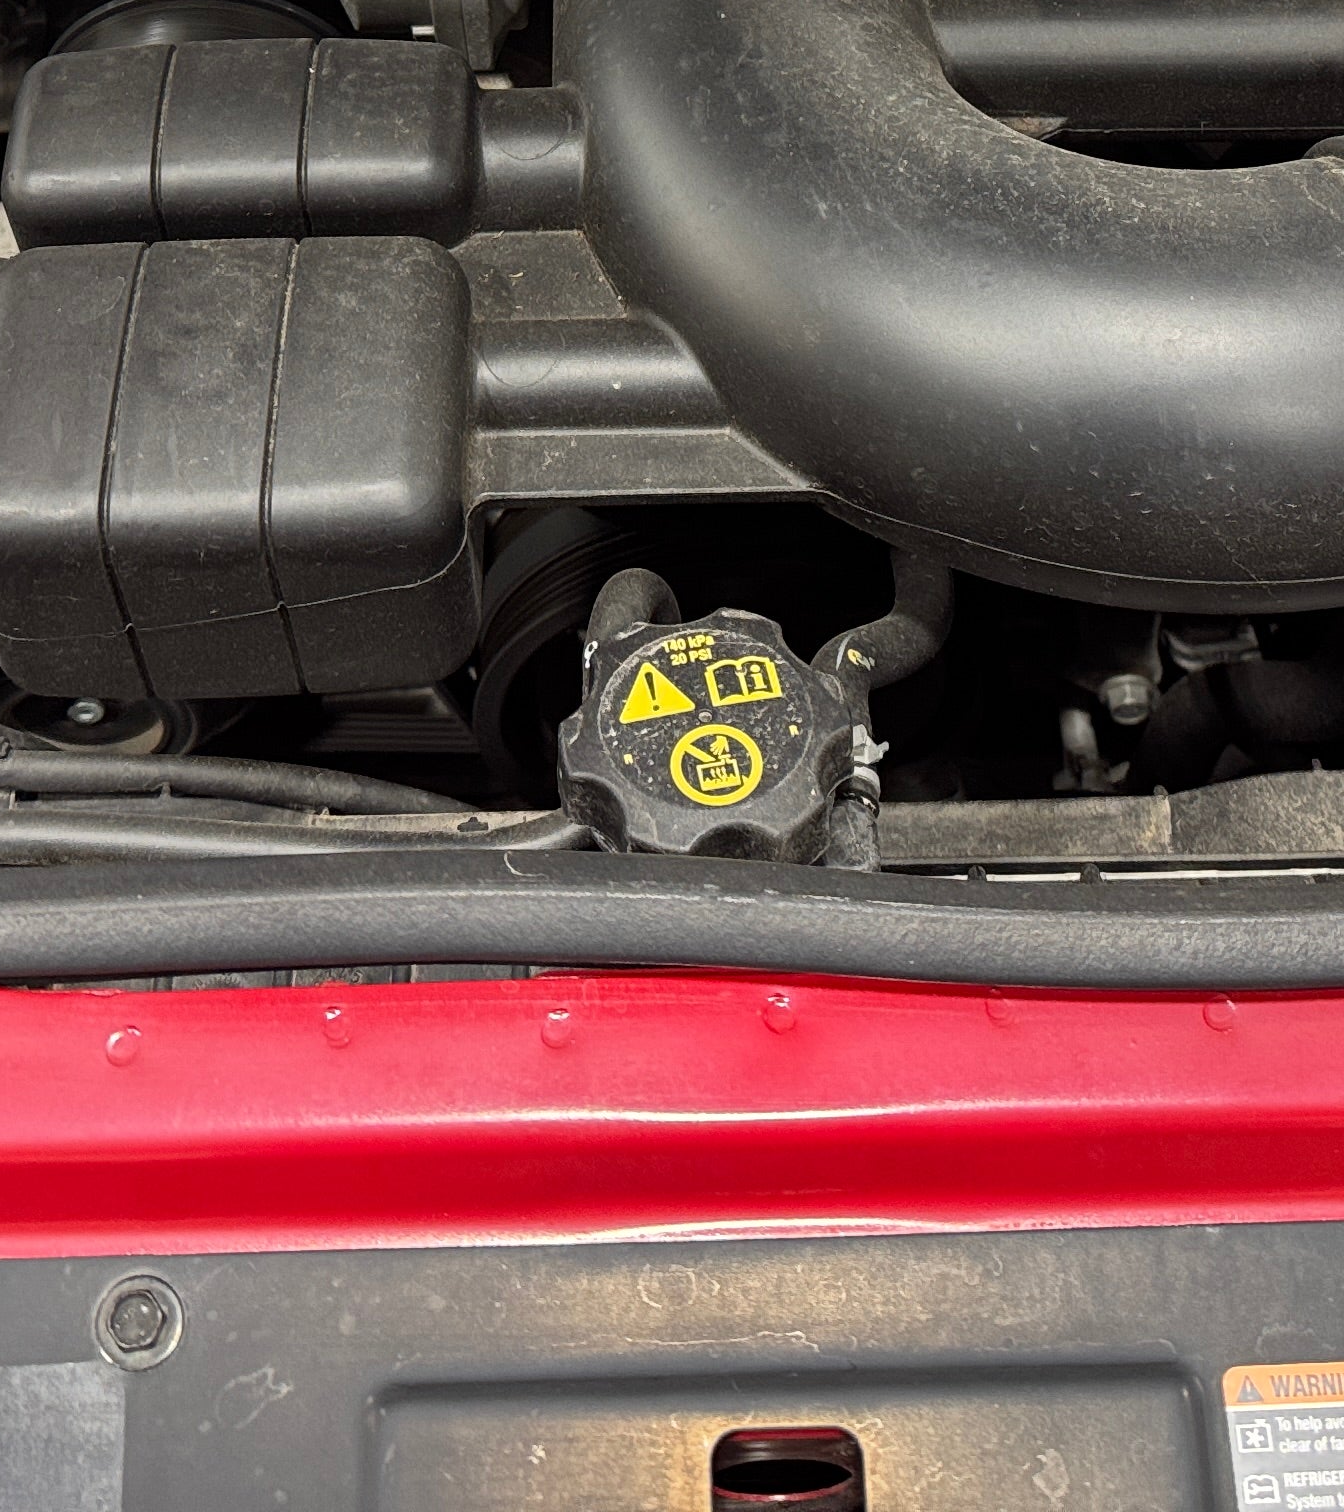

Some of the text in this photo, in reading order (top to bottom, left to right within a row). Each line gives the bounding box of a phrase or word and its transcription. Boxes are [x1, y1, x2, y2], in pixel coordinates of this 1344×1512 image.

[661, 634, 715, 654] 140 kPa
[670, 647, 713, 666] 20 PSI
[1274, 1416, 1293, 1432] To
[1293, 1415, 1324, 1433] help
[1279, 1437, 1312, 1454] clear
[1314, 1436, 1328, 1451] of
[1286, 1489, 1336, 1511] System
